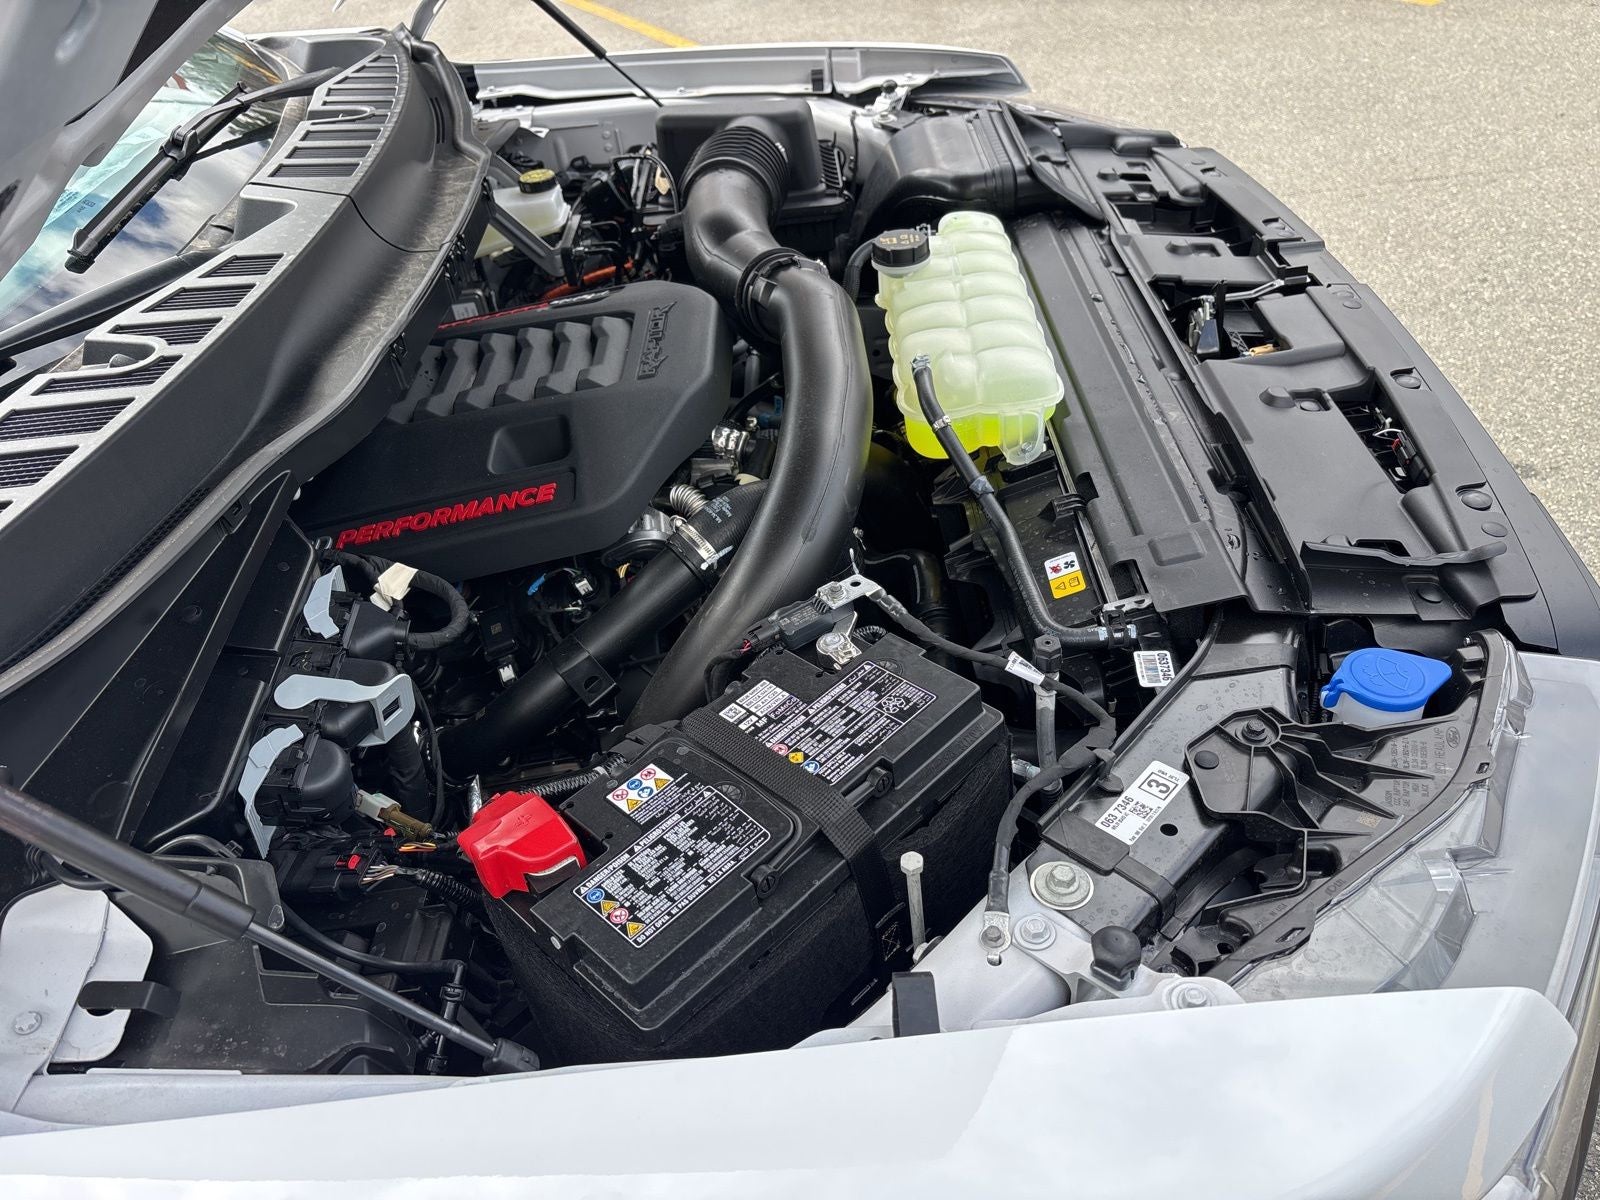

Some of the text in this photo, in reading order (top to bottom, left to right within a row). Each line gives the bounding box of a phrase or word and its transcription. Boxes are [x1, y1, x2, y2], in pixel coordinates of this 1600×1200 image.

[635, 302, 677, 380] RAPTOR
[336, 482, 557, 549] PERFORMANCE
[742, 717, 754, 726] 12V
[754, 716, 770, 727] MF
[769, 696, 798, 718] FoMoCo
[1146, 778, 1171, 794] 3
[1100, 813, 1118, 828] 063
[1113, 795, 1134, 814] 7346
[638, 812, 681, 847] PELIGRO/VENENO
[584, 851, 630, 889] DANGER/POISON
[706, 858, 737, 884] NO LA ABRA.
[669, 881, 709, 915] NE PAS OUVRIR.
[635, 912, 672, 943] DO NOT OPEN.
